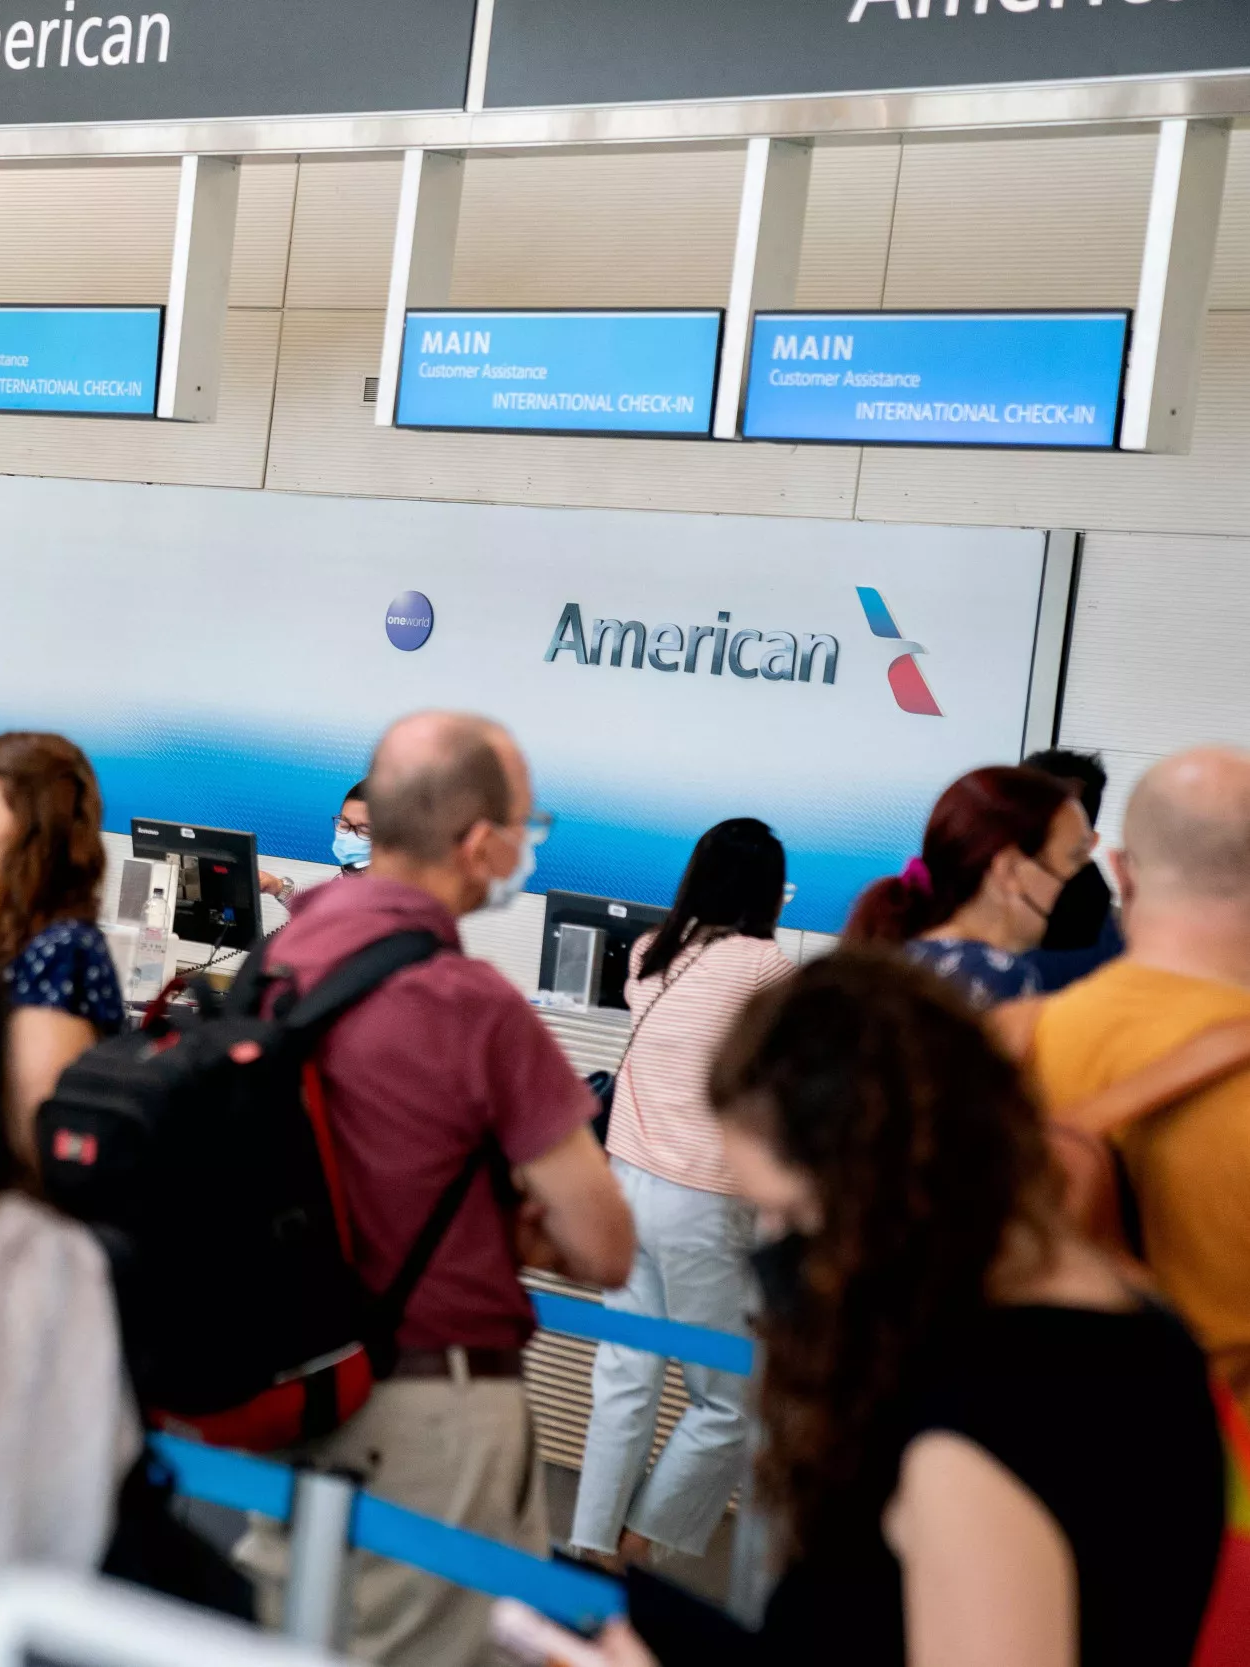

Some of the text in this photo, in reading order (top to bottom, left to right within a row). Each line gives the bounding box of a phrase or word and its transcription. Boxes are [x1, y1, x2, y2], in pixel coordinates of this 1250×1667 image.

[421, 331, 491, 354] MAIN
[771, 335, 854, 361] MAIN
[419, 362, 548, 380] Customer Assistance
[769, 368, 921, 389] Customer Assistance
[83, 380, 142, 397] CHECK-IN
[492, 392, 694, 414] INTERNATIONAL CHECK-IN
[855, 401, 1096, 425] INTERNATIONAL CHECK-IN
[543, 602, 840, 685] American
